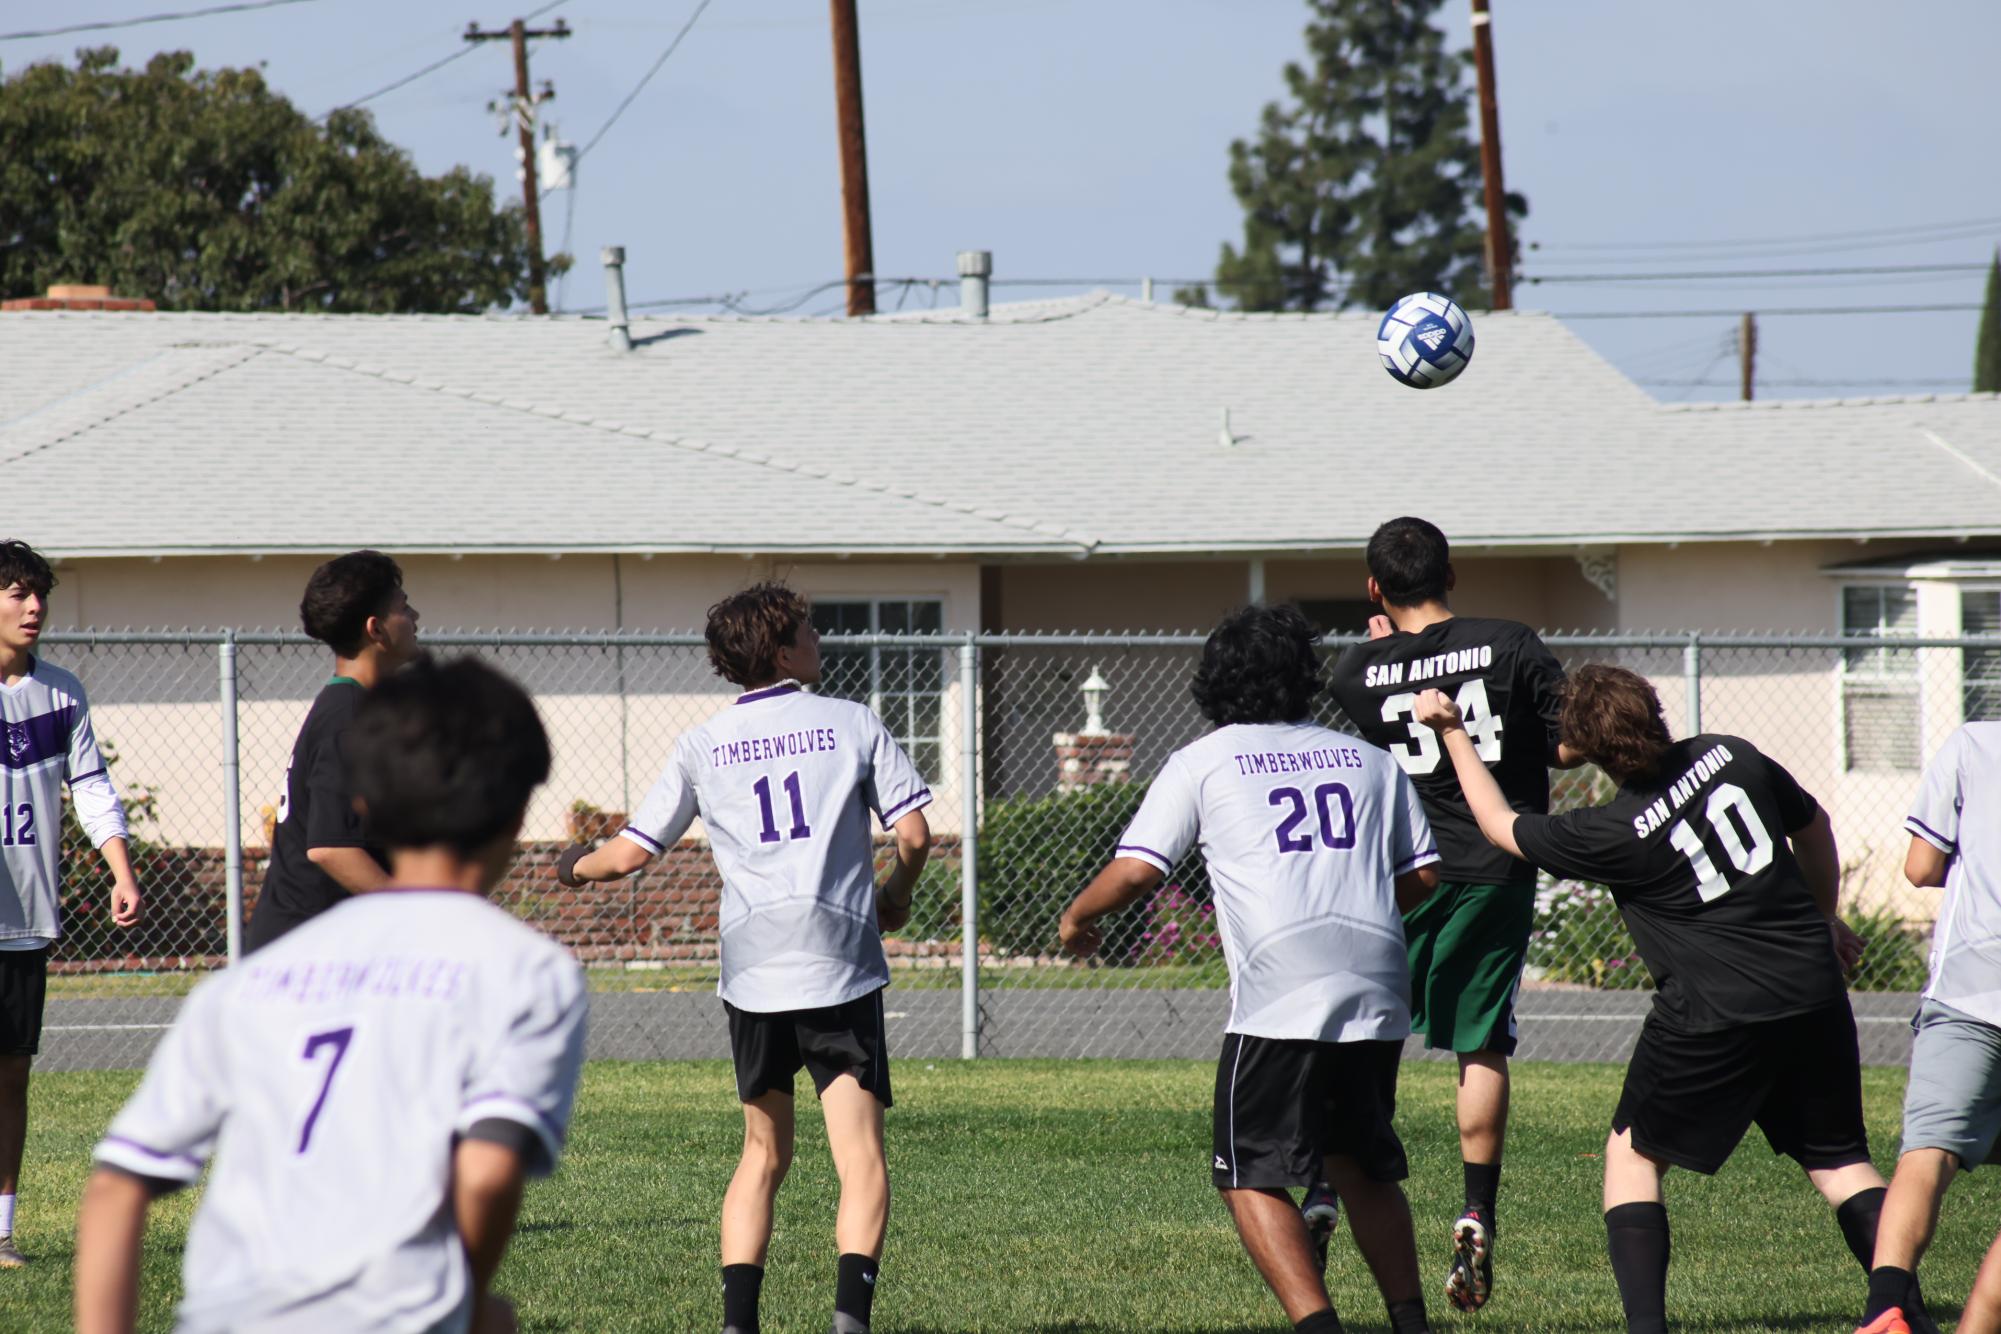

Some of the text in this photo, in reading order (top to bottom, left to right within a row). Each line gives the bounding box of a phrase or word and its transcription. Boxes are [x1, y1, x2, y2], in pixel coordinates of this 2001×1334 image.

[1365, 645, 1492, 688] SAN ANTONIO
[712, 728, 836, 767] TIMBERWOLVES
[1235, 748, 1363, 775] TIMBERWOLVES
[1380, 678, 1504, 775] 34
[3, 802, 36, 847] 12
[753, 770, 811, 844] 11
[1268, 782, 1356, 853] 20
[1633, 744, 1733, 839] SAN ANTONIO
[1669, 782, 1774, 903] 10
[298, 1026, 354, 1153] 7
